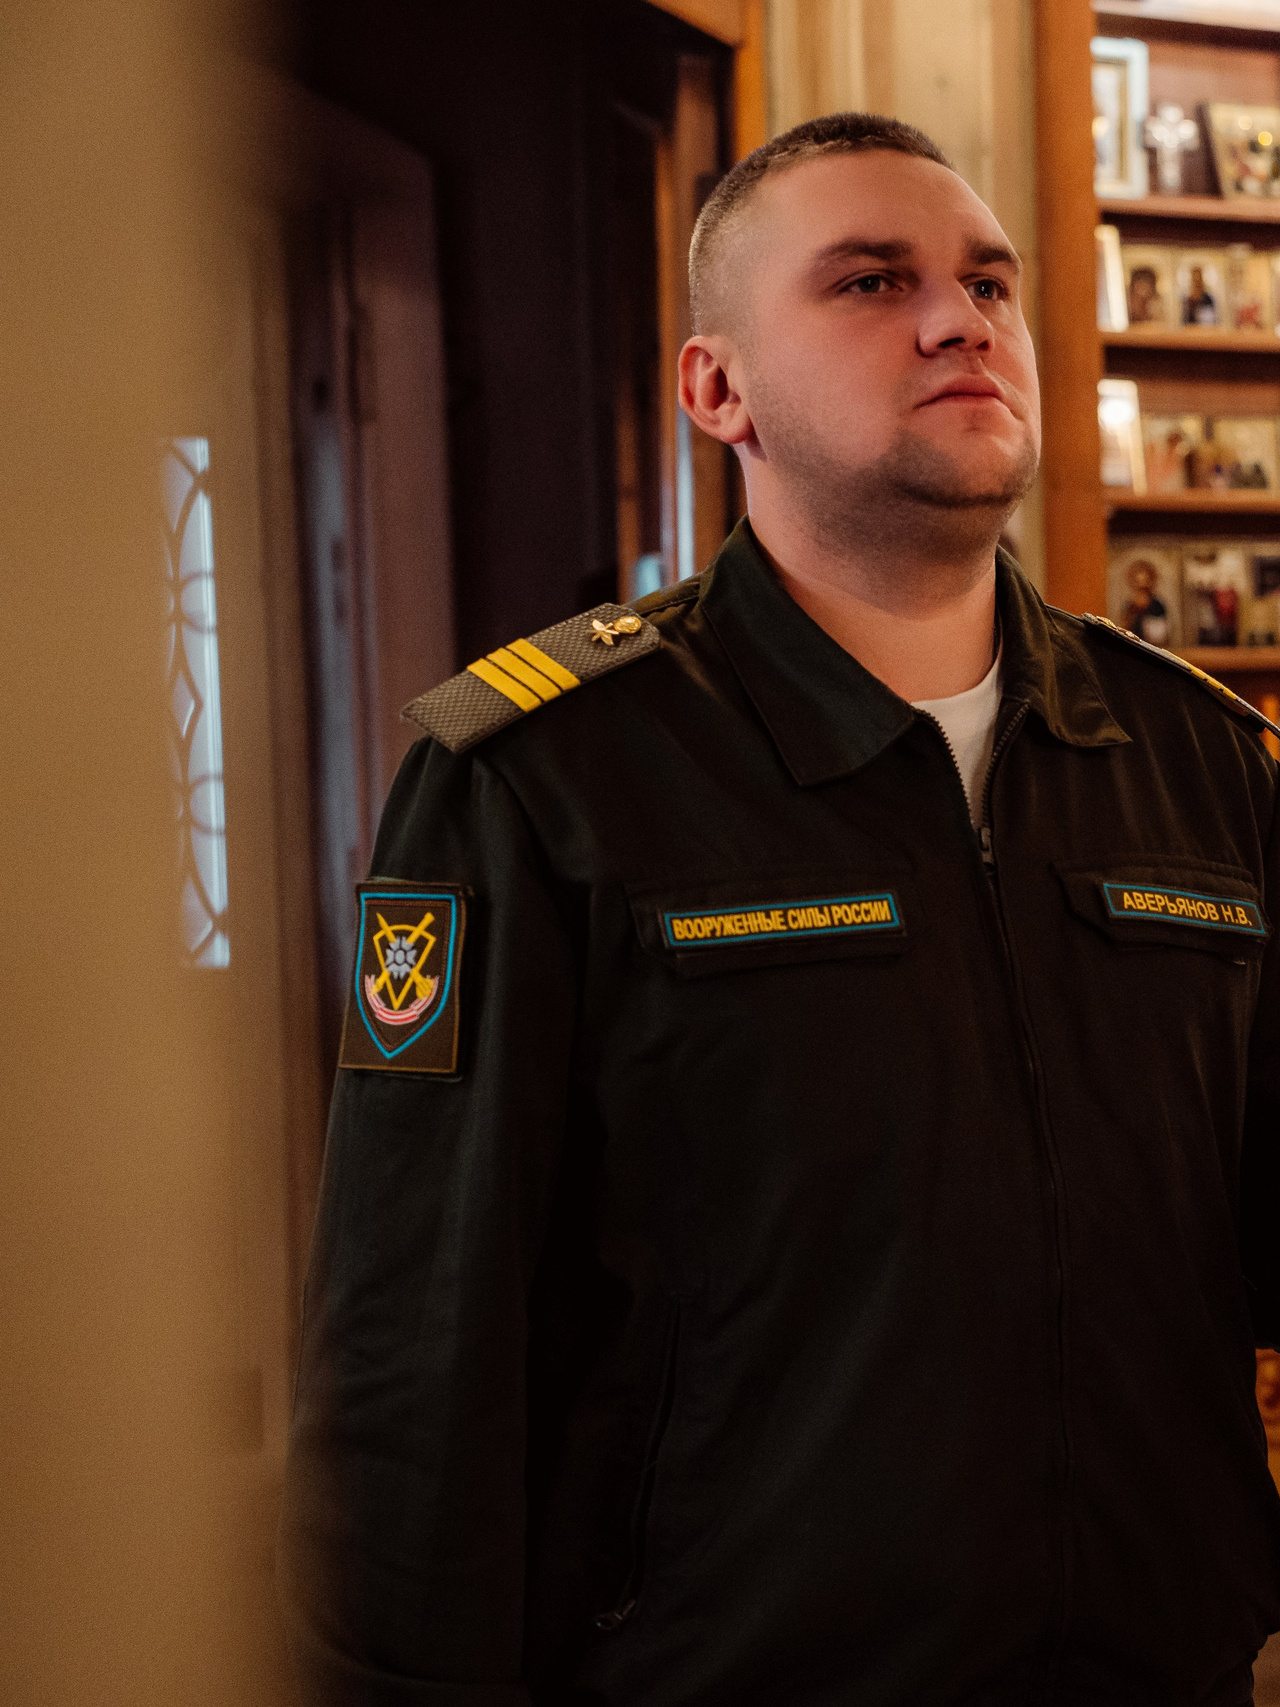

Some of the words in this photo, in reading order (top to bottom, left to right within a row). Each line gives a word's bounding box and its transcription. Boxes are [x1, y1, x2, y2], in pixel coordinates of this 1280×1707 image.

[671, 909, 788, 940] ВООРУЖЕННЫЕ
[787, 905, 832, 930] СИЛЫ
[830, 900, 892, 926] РОССИИ
[1122, 891, 1220, 921] АВЕРЬЯНОВ
[1221, 904, 1253, 927] Н.В.
